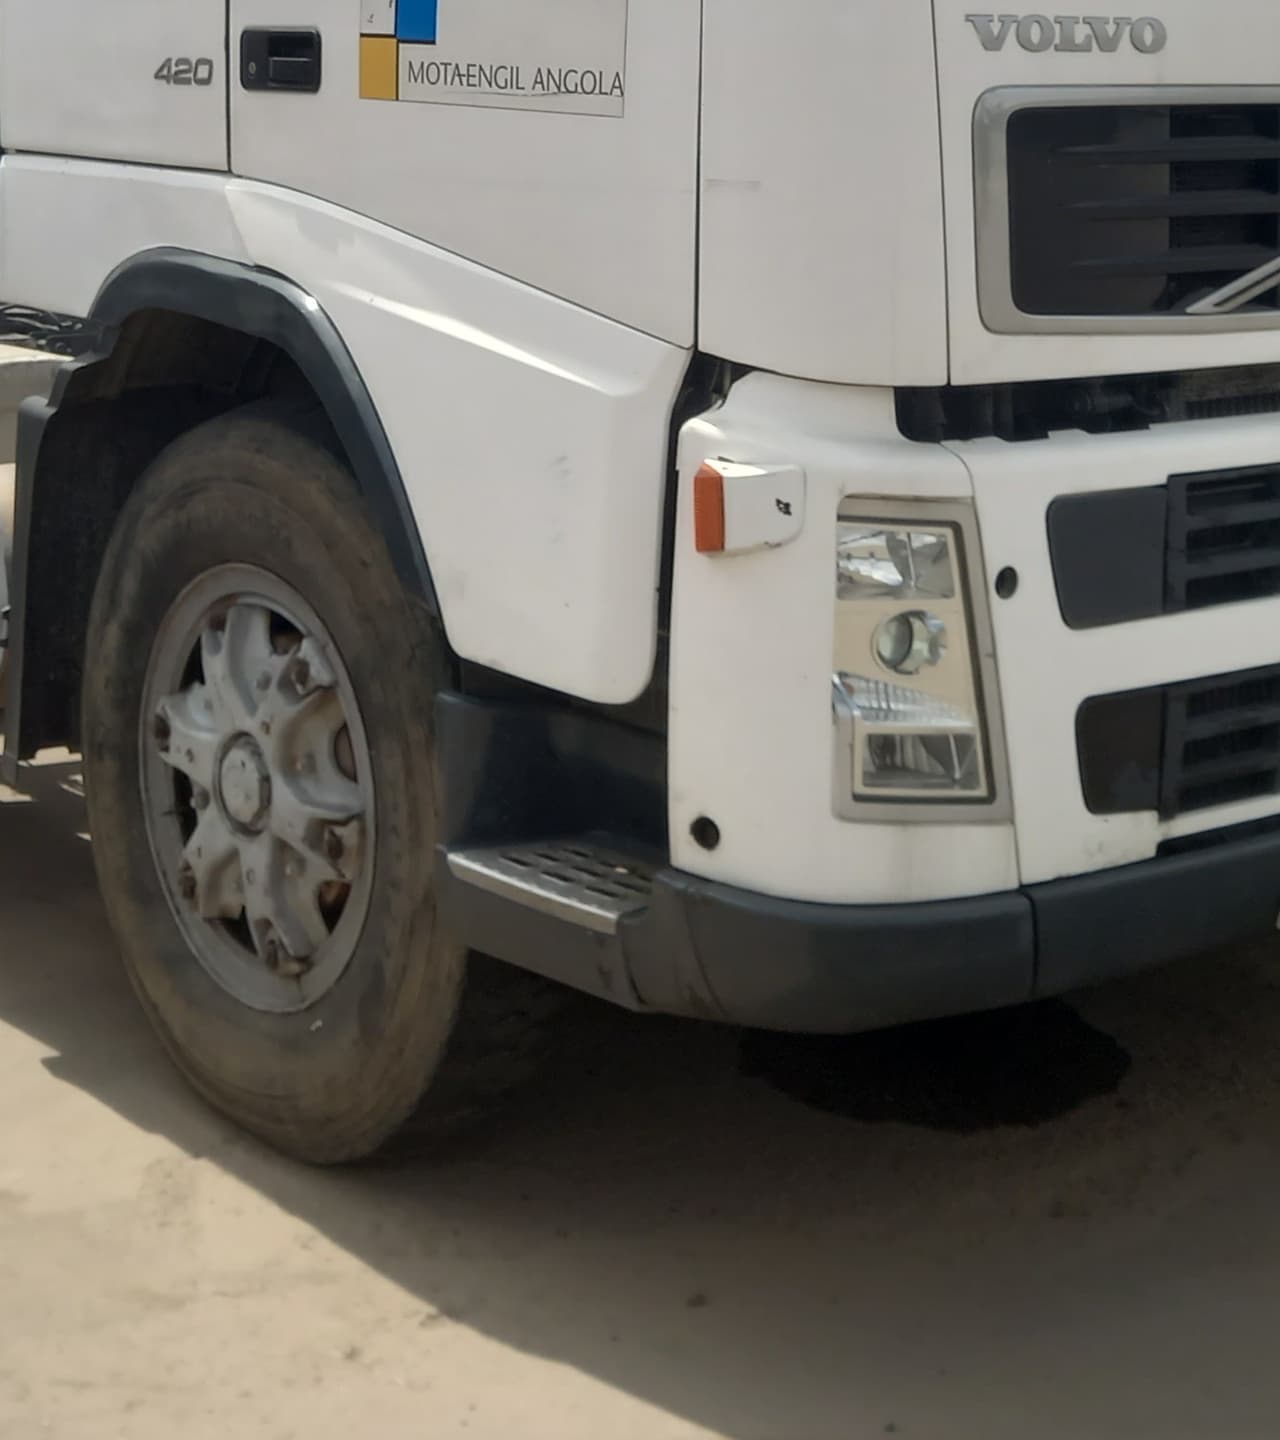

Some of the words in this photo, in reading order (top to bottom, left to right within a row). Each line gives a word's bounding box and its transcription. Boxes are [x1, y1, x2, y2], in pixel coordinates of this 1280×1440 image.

[965, 14, 1167, 54] VOLVO
[154, 57, 213, 85] 420
[531, 66, 624, 96] ANGOLA
